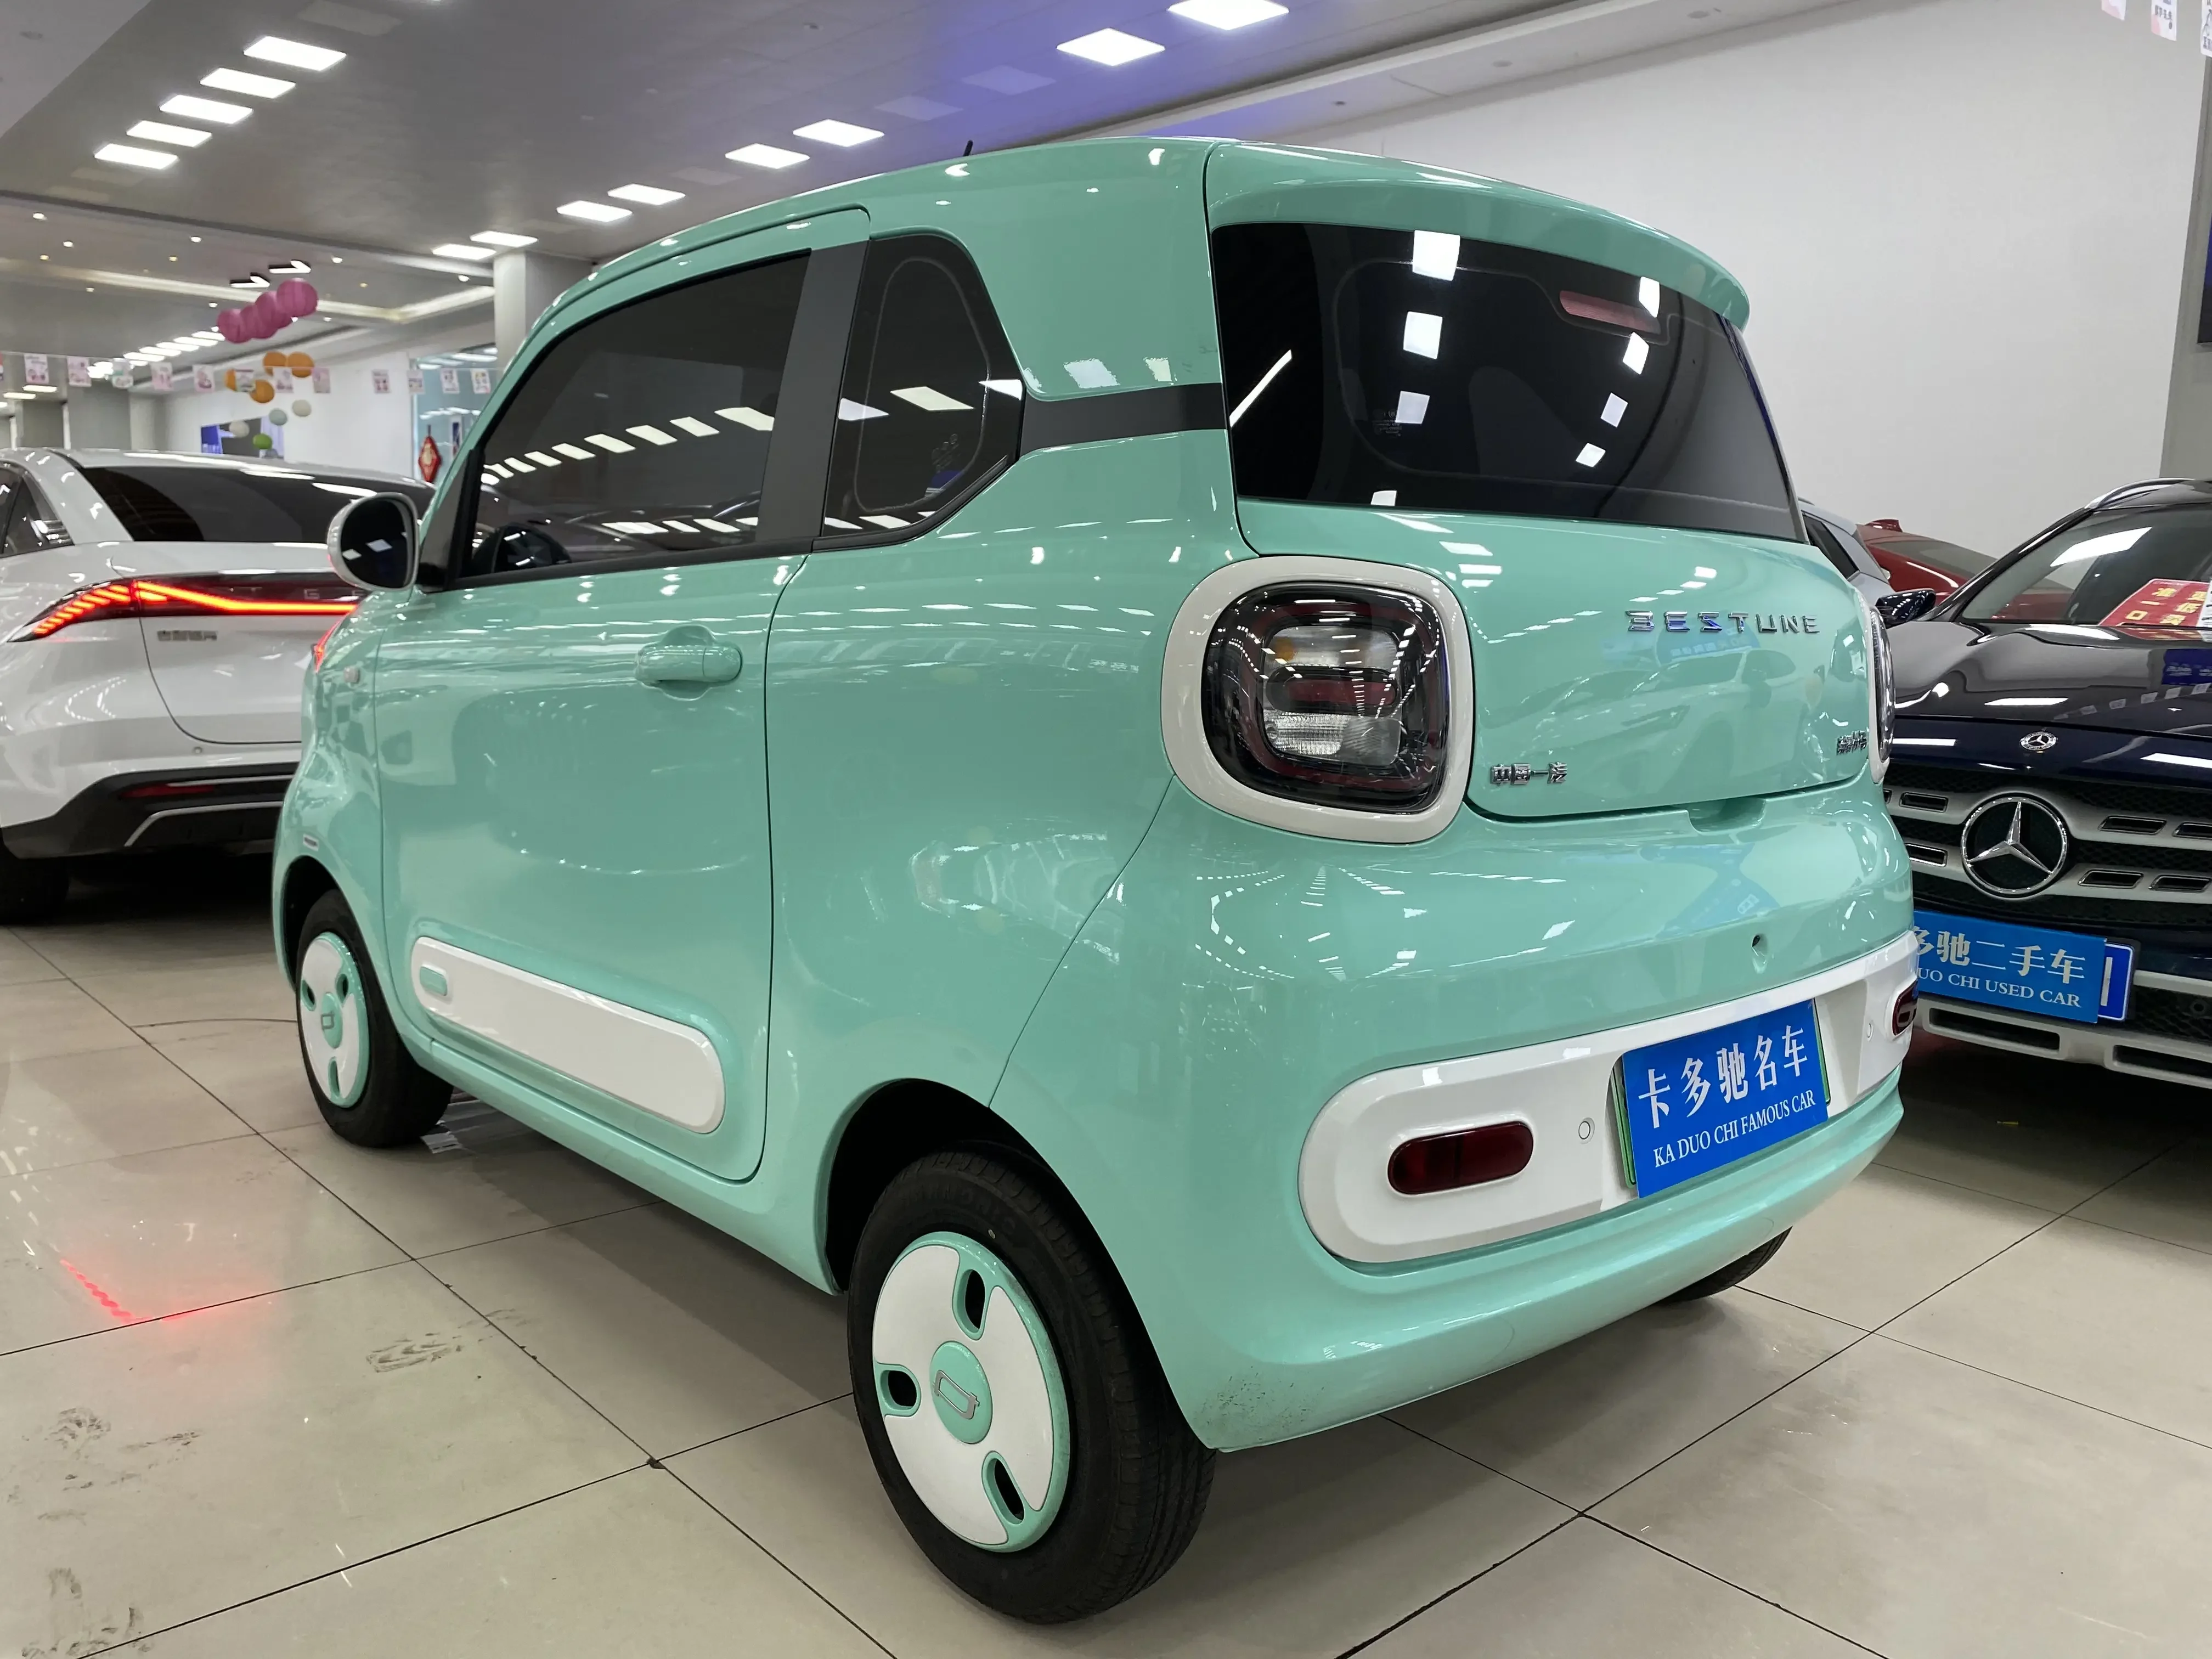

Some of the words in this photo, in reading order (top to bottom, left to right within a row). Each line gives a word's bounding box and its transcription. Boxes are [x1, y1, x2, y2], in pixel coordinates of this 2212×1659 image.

[1626, 610, 1820, 634] BESTUNE
[1948, 973, 1980, 990] CHI
[1985, 980, 2034, 999] USED
[2040, 990, 2082, 1008] CAR
[1638, 1025, 1808, 1129] 卡多驰名车
[1653, 1144, 1676, 1168] KA
[1677, 1131, 1711, 1160] DUO
[1714, 1120, 1739, 1144] CHI
[1741, 1099, 1790, 1135] FAMOUS
[1791, 1089, 1816, 1114] CAR
